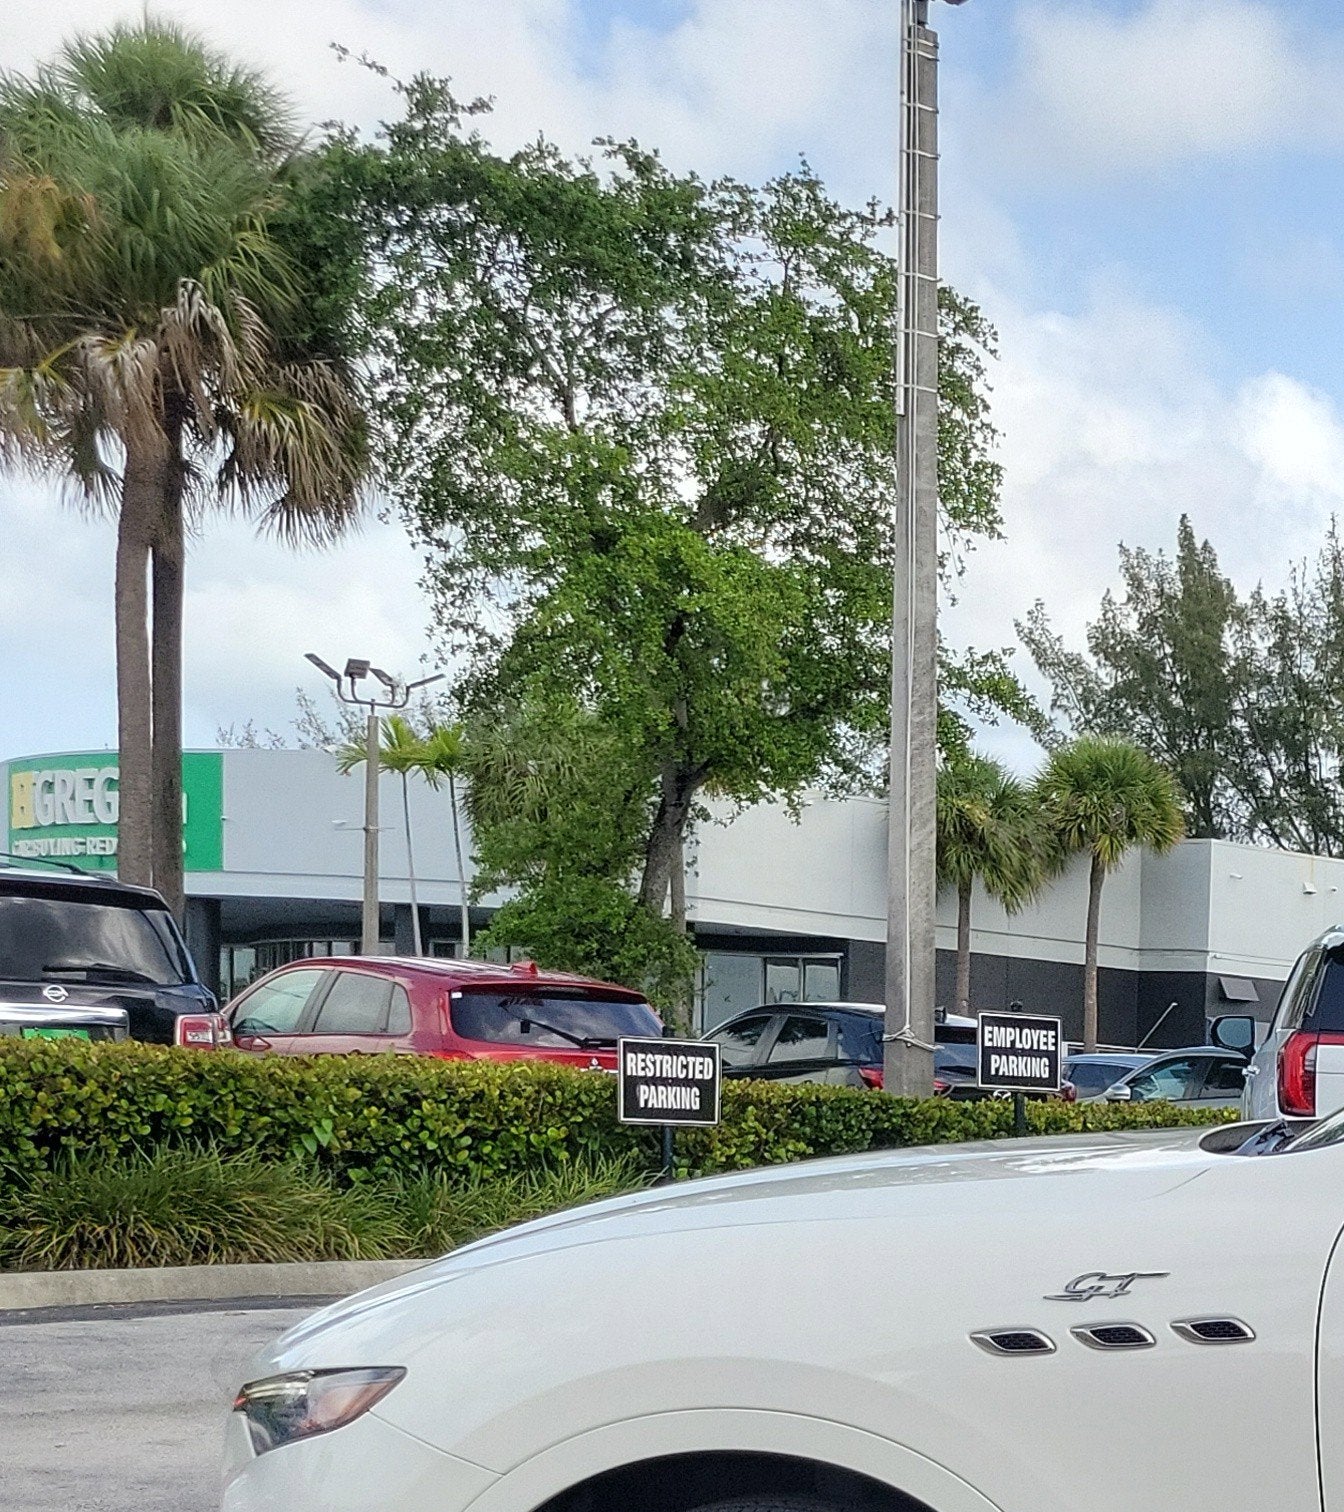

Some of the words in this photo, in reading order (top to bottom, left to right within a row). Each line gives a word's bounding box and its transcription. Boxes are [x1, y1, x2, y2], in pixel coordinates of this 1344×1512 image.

[984, 1025, 1056, 1051] EMPLOYEE
[626, 1052, 714, 1080] RESTRICTED
[990, 1054, 1050, 1079] PARKING
[639, 1084, 701, 1111] PARKING
[1041, 1271, 1171, 1302] GT
